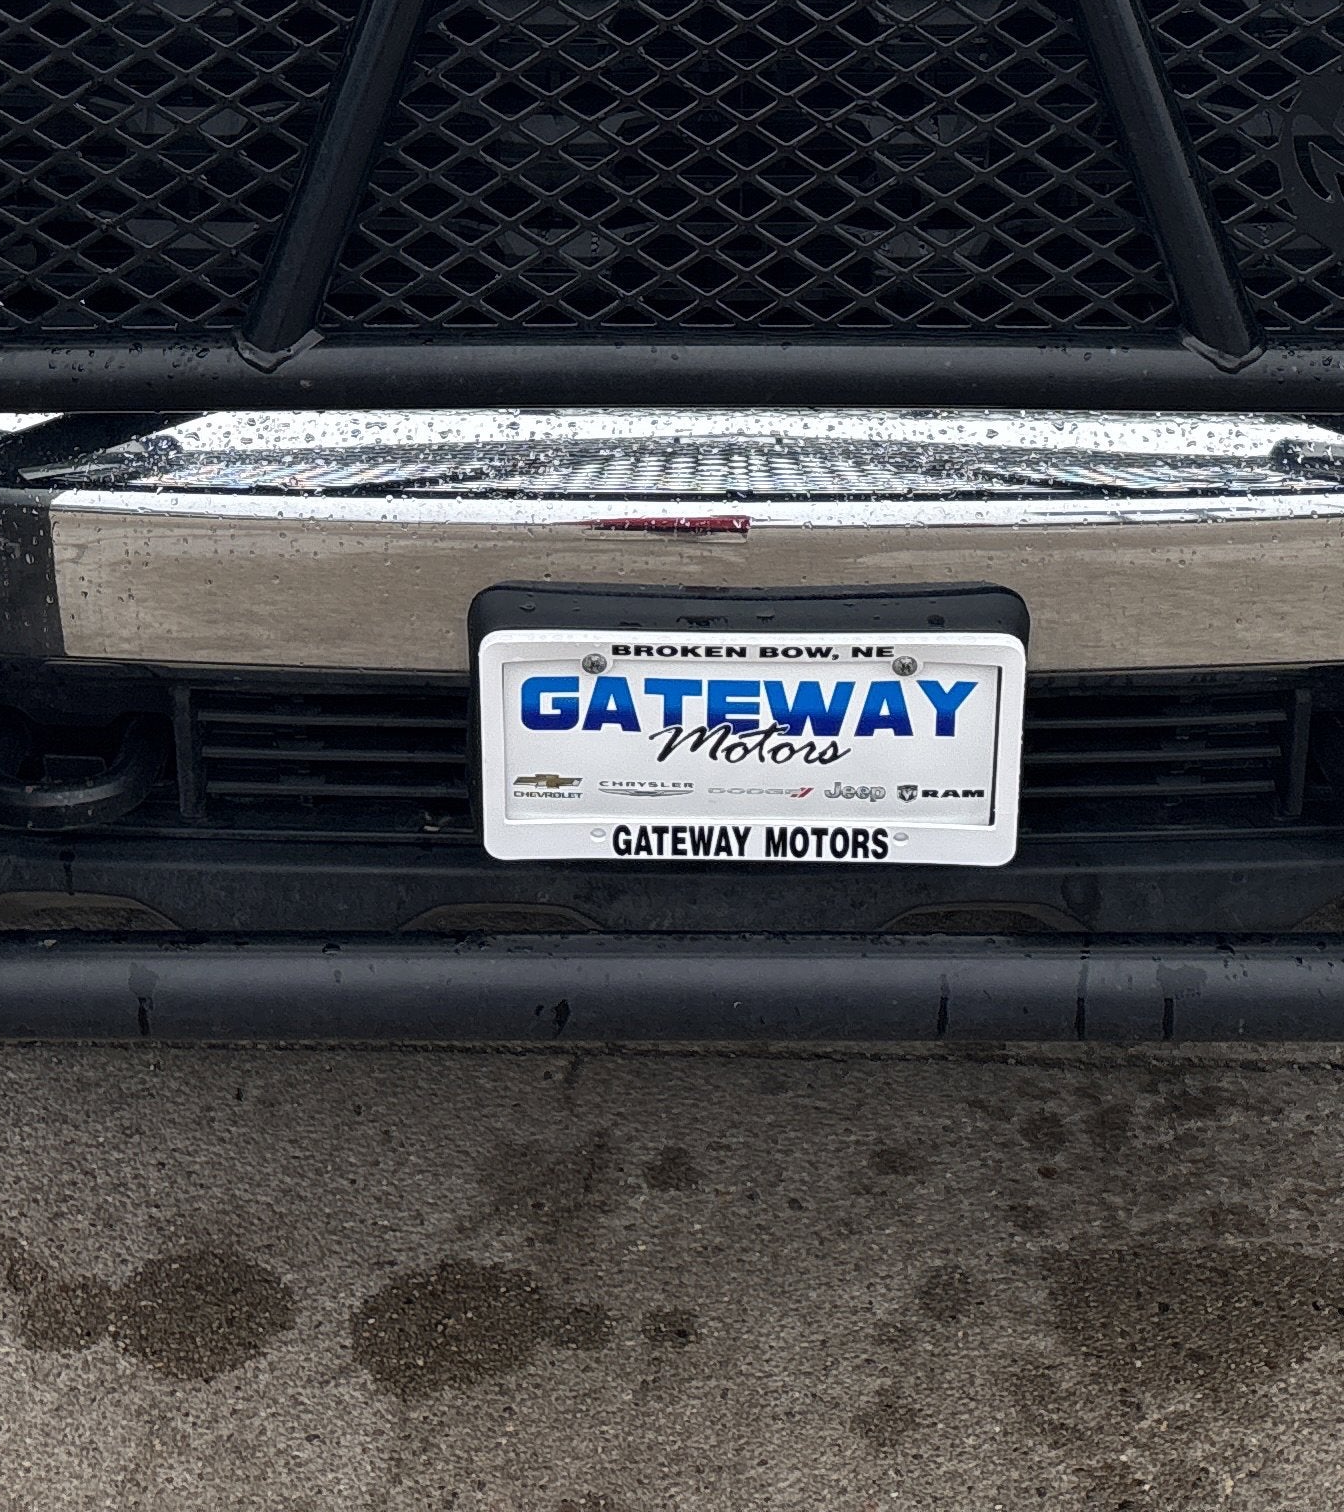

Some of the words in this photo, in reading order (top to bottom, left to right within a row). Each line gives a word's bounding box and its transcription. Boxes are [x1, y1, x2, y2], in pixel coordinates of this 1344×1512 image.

[611, 644, 748, 659] BROKEN
[759, 646, 840, 661] BOW,
[852, 646, 895, 659] NE
[520, 676, 979, 737] GATEWAY
[648, 721, 853, 765] Motors
[598, 780, 695, 789] CHRYSLER
[824, 781, 887, 802] Jeep
[921, 789, 985, 798] RAM
[513, 790, 584, 799] CHEVROLET
[612, 824, 752, 857] GATEWAY
[764, 826, 889, 859] MOTORS
